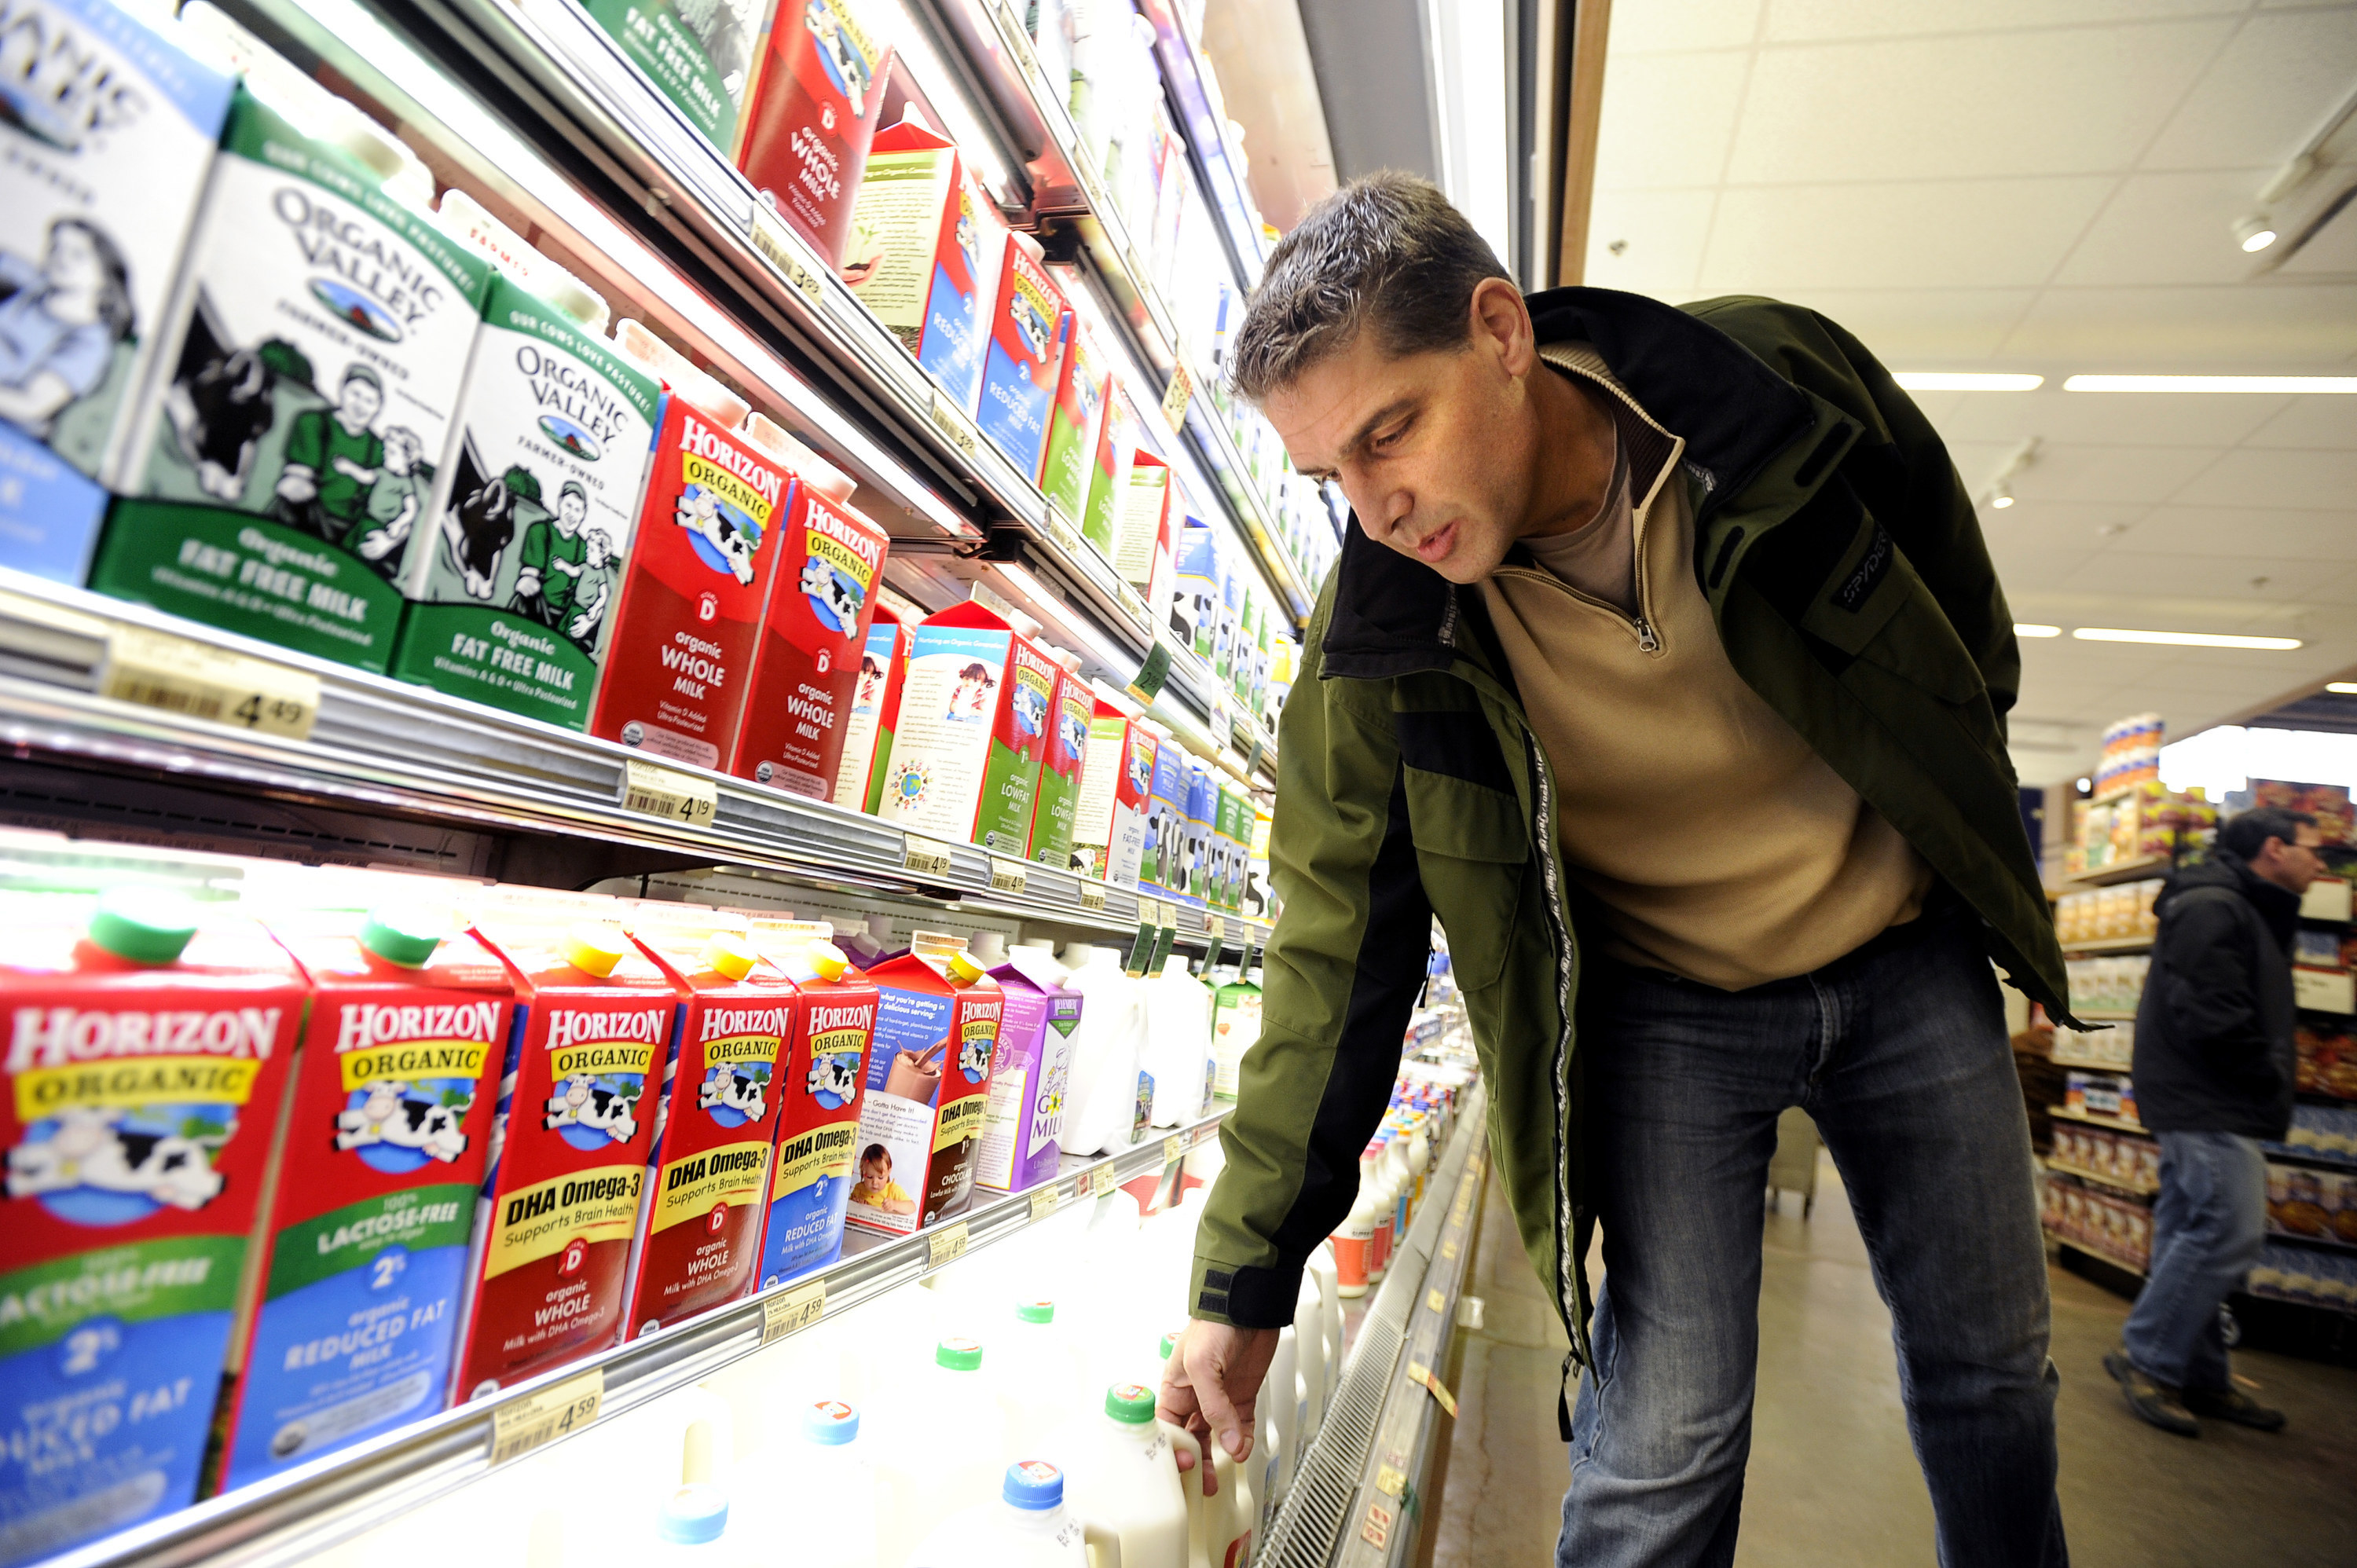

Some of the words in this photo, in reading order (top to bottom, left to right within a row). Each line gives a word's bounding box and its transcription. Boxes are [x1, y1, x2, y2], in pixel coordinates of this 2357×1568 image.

[626, 7, 658, 42] FAT
[657, 37, 691, 82] FREE
[691, 75, 720, 118] MILK
[790, 131, 841, 199] WHOLE
[802, 126, 839, 171] organic
[799, 167, 825, 202] MILK
[271, 187, 445, 313] ORGANIC
[295, 230, 424, 325] VALLEY
[1012, 248, 1062, 318] HORIZON
[510, 310, 537, 329] OUR
[540, 319, 574, 347] COWS
[576, 337, 603, 367] LOVE
[516, 346, 629, 432] ORGANIC
[530, 379, 616, 445] VALLEY
[989, 381, 1028, 422] REDUCED
[1028, 416, 1041, 435] FAT
[518, 434, 604, 490] FARMER-OWNED
[679, 415, 782, 507] HORIZON
[689, 461, 768, 520] ORGANIC
[804, 497, 882, 571] HORIZON
[238, 527, 339, 577] Organic
[812, 537, 869, 583] ORGANIC
[1843, 532, 1886, 603] SPYDER
[178, 538, 240, 577] FAT
[240, 559, 307, 603] FREE
[307, 582, 368, 622] MILK
[698, 599, 716, 621] D
[491, 621, 555, 655] Organic
[675, 631, 722, 660] organic
[434, 655, 477, 679] Vitamins
[451, 633, 489, 661] FAT
[491, 646, 534, 678] FREE
[535, 661, 575, 691] MILK
[661, 644, 724, 687] WHOLE
[817, 654, 830, 673] D
[1015, 643, 1056, 686] HORIZON
[673, 676, 706, 700] MILK
[798, 683, 833, 705] organic
[1018, 669, 1050, 697] ORGANIC
[1061, 679, 1094, 710] HORIZON
[787, 695, 834, 729] WHOLE
[1064, 701, 1090, 725] ORGANIC
[795, 721, 820, 741] MILK
[1001, 782, 1030, 804] LOWFAT
[1010, 774, 1029, 787] organic
[1008, 801, 1021, 813] MILK
[807, 1005, 874, 1035] HORIZON
[880, 994, 896, 1003] what
[897, 996, 915, 1007] you're
[915, 999, 937, 1012] getting
[938, 1002, 945, 1011] in
[884, 1002, 911, 1015] delicious
[911, 1008, 936, 1020] serving:
[960, 1002, 1001, 1023] HORIZON
[5, 1006, 283, 1074] HORIZON
[334, 1001, 501, 1054] HORIZON
[544, 1009, 666, 1050] HORIZON
[699, 1007, 790, 1042] HORIZON
[964, 1023, 995, 1037] ORGANIC
[709, 1039, 776, 1061] ORGANIC
[815, 1033, 863, 1051] ORGANIC
[353, 1048, 480, 1080] ORGANIC
[559, 1050, 649, 1072] ORGANIC
[33, 1064, 248, 1105] ORGANIC
[873, 1100, 889, 1109] Gotta
[891, 1104, 906, 1112] Have
[941, 1104, 961, 1125] DHA
[940, 1119, 966, 1136] Supports
[783, 1140, 812, 1165] DHA
[815, 1127, 856, 1153] Omega-3
[667, 1159, 705, 1192] DHA
[709, 1148, 768, 1176] Omega-3
[783, 1158, 820, 1179] Supports
[822, 1152, 838, 1165] Brain
[838, 1150, 852, 1161] Health
[953, 1162, 968, 1171] organic
[505, 1185, 556, 1228] DHA
[562, 1173, 641, 1207] Omega-3
[666, 1181, 716, 1208] Supports
[719, 1176, 740, 1193] Brain
[742, 1174, 763, 1188] Health
[815, 1180, 828, 1198] 2%
[317, 1202, 460, 1255] LACTOSE-FREE
[504, 1214, 570, 1247] Supports
[574, 1207, 603, 1225] Brain
[605, 1203, 634, 1218] Health
[711, 1211, 723, 1230] D
[785, 1218, 825, 1243] REDUCED
[827, 1213, 839, 1227] FAT
[805, 1205, 828, 1222] organic
[566, 1248, 582, 1271] D
[696, 1237, 727, 1256] organic
[781, 1243, 794, 1255] Milk
[795, 1240, 805, 1250] with
[805, 1236, 817, 1247] DHA
[370, 1252, 408, 1290] 2%
[664, 1284, 680, 1296] Milk
[682, 1278, 695, 1291] with
[697, 1273, 713, 1287] DHA
[713, 1262, 739, 1280] Omega-3
[687, 1250, 729, 1277] WHOLE
[545, 1278, 588, 1302] organic
[766, 1296, 786, 1310] Horizon
[347, 1293, 411, 1329] organic
[535, 1293, 591, 1327] WHOLE
[283, 1312, 406, 1371] REDUCED
[410, 1298, 448, 1332] FAT
[503, 1336, 526, 1353] Milk
[527, 1328, 546, 1344] with
[548, 1321, 568, 1339] DHA
[570, 1306, 604, 1330] Omega-3
[349, 1343, 392, 1372] MILK
